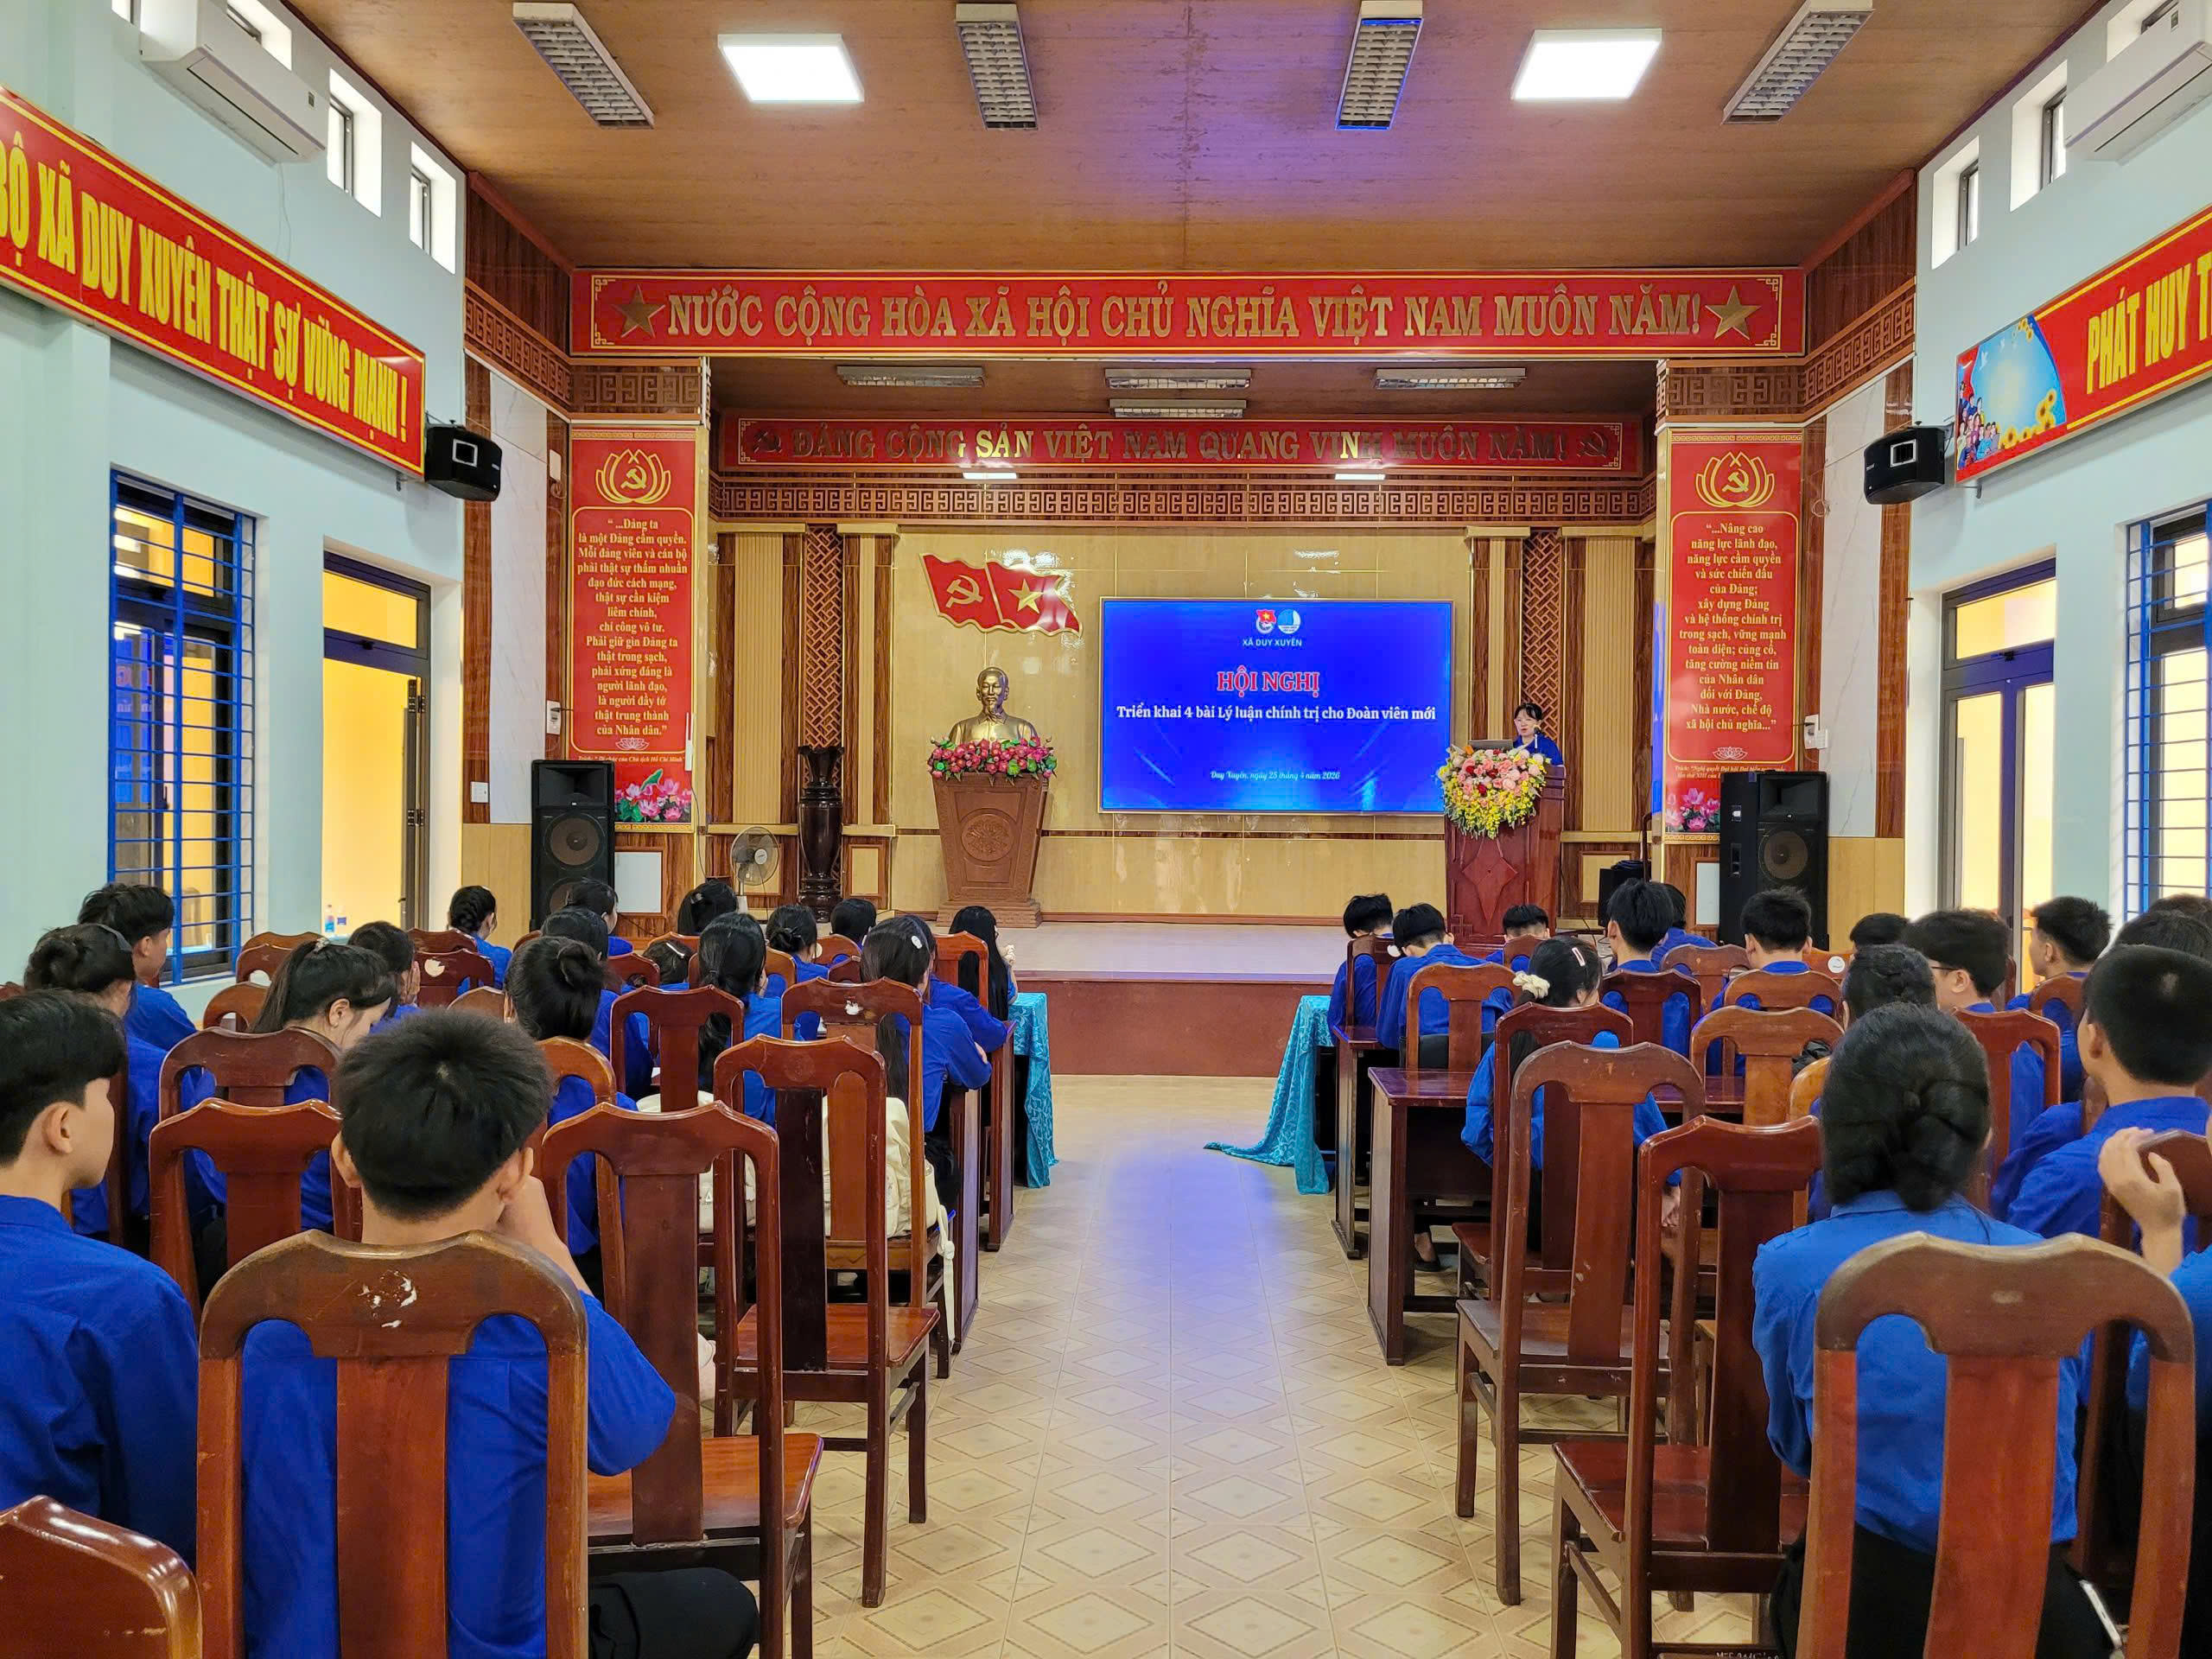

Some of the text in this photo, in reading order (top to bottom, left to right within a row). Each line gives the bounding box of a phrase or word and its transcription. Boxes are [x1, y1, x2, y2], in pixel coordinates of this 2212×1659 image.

[37, 159, 76, 275] XÃ
[81, 191, 133, 305] DUY
[138, 234, 212, 345] XUYÊN
[216, 270, 270, 380] THẬT
[273, 301, 301, 401] SỰ
[303, 315, 350, 414] VỮNG
[668, 280, 1700, 346] NƯỚC CỘNG HÒA XÃ HỘI CHỦ NGHĨA VIỆT NAM MUÔN NĂM!
[2087, 286, 2140, 394] PHÁT
[2145, 263, 2191, 366] HUY
[792, 422, 875, 459] ĐẢNG
[885, 423, 965, 462] CỘNG
[975, 422, 1033, 459] SẢN
[1043, 423, 1114, 462] VIỆT
[1123, 430, 1188, 459] NAM
[1198, 430, 1300, 461] QUANG
[1309, 431, 1382, 460] VINH
[1392, 424, 1478, 460] MUÔN
[1692, 538, 1714, 551] năng
[1718, 538, 1732, 551] lực
[1735, 538, 1755, 549] lãnh
[1688, 553, 1711, 567] năng
[1713, 553, 1728, 567] lực
[1695, 569, 1707, 579] và
[1709, 569, 1725, 579] sức
[1710, 583, 1726, 594] của
[1698, 598, 1769, 612] xây dựng Đảng
[1685, 613, 1782, 626] và hệ chính trị
[1243, 637, 1254, 646] XÃ
[1274, 637, 1302, 646] XUYÊN
[1680, 628, 1705, 642] trong
[1734, 628, 1757, 642] vững
[1760, 628, 1786, 642] mạnh
[1688, 644, 1709, 654] toàn
[1738, 644, 1762, 657] củng
[1686, 658, 1706, 672] tăng
[1708, 658, 1738, 672] cường
[1766, 658, 1779, 670] tin
[1217, 664, 1320, 698] HỘI NGHỊ
[1700, 674, 1764, 684] của Nhân dân
[1718, 689, 1732, 700] với
[1116, 702, 1436, 722] Triển khai 4 bài Lý luận chính trị cho Đoàn viên mới
[1692, 704, 1709, 715] Nhà
[1760, 704, 1771, 717] độ
[1687, 719, 1696, 729] xã
[1700, 719, 1713, 732] hội
[1716, 719, 1733, 729] chủ
